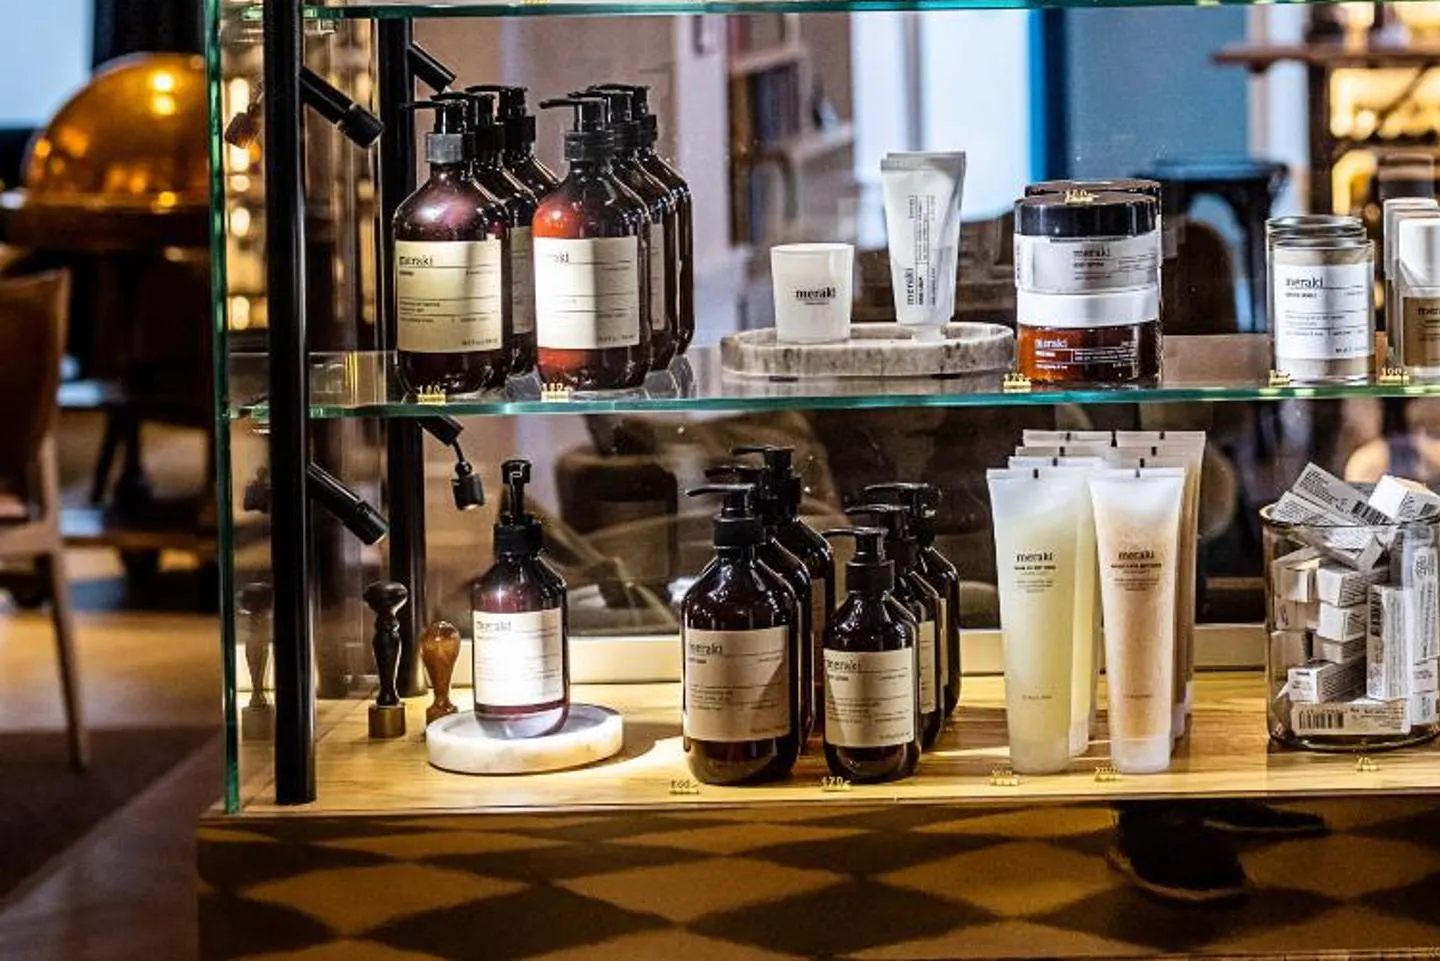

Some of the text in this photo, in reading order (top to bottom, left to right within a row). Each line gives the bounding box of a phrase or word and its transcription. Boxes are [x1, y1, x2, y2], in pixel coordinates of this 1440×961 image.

[904, 267, 916, 307] meraki
[1285, 276, 1324, 289] meraki
[795, 286, 836, 300] meraki
[1015, 550, 1054, 562] meraki
[1117, 549, 1156, 561] meraki
